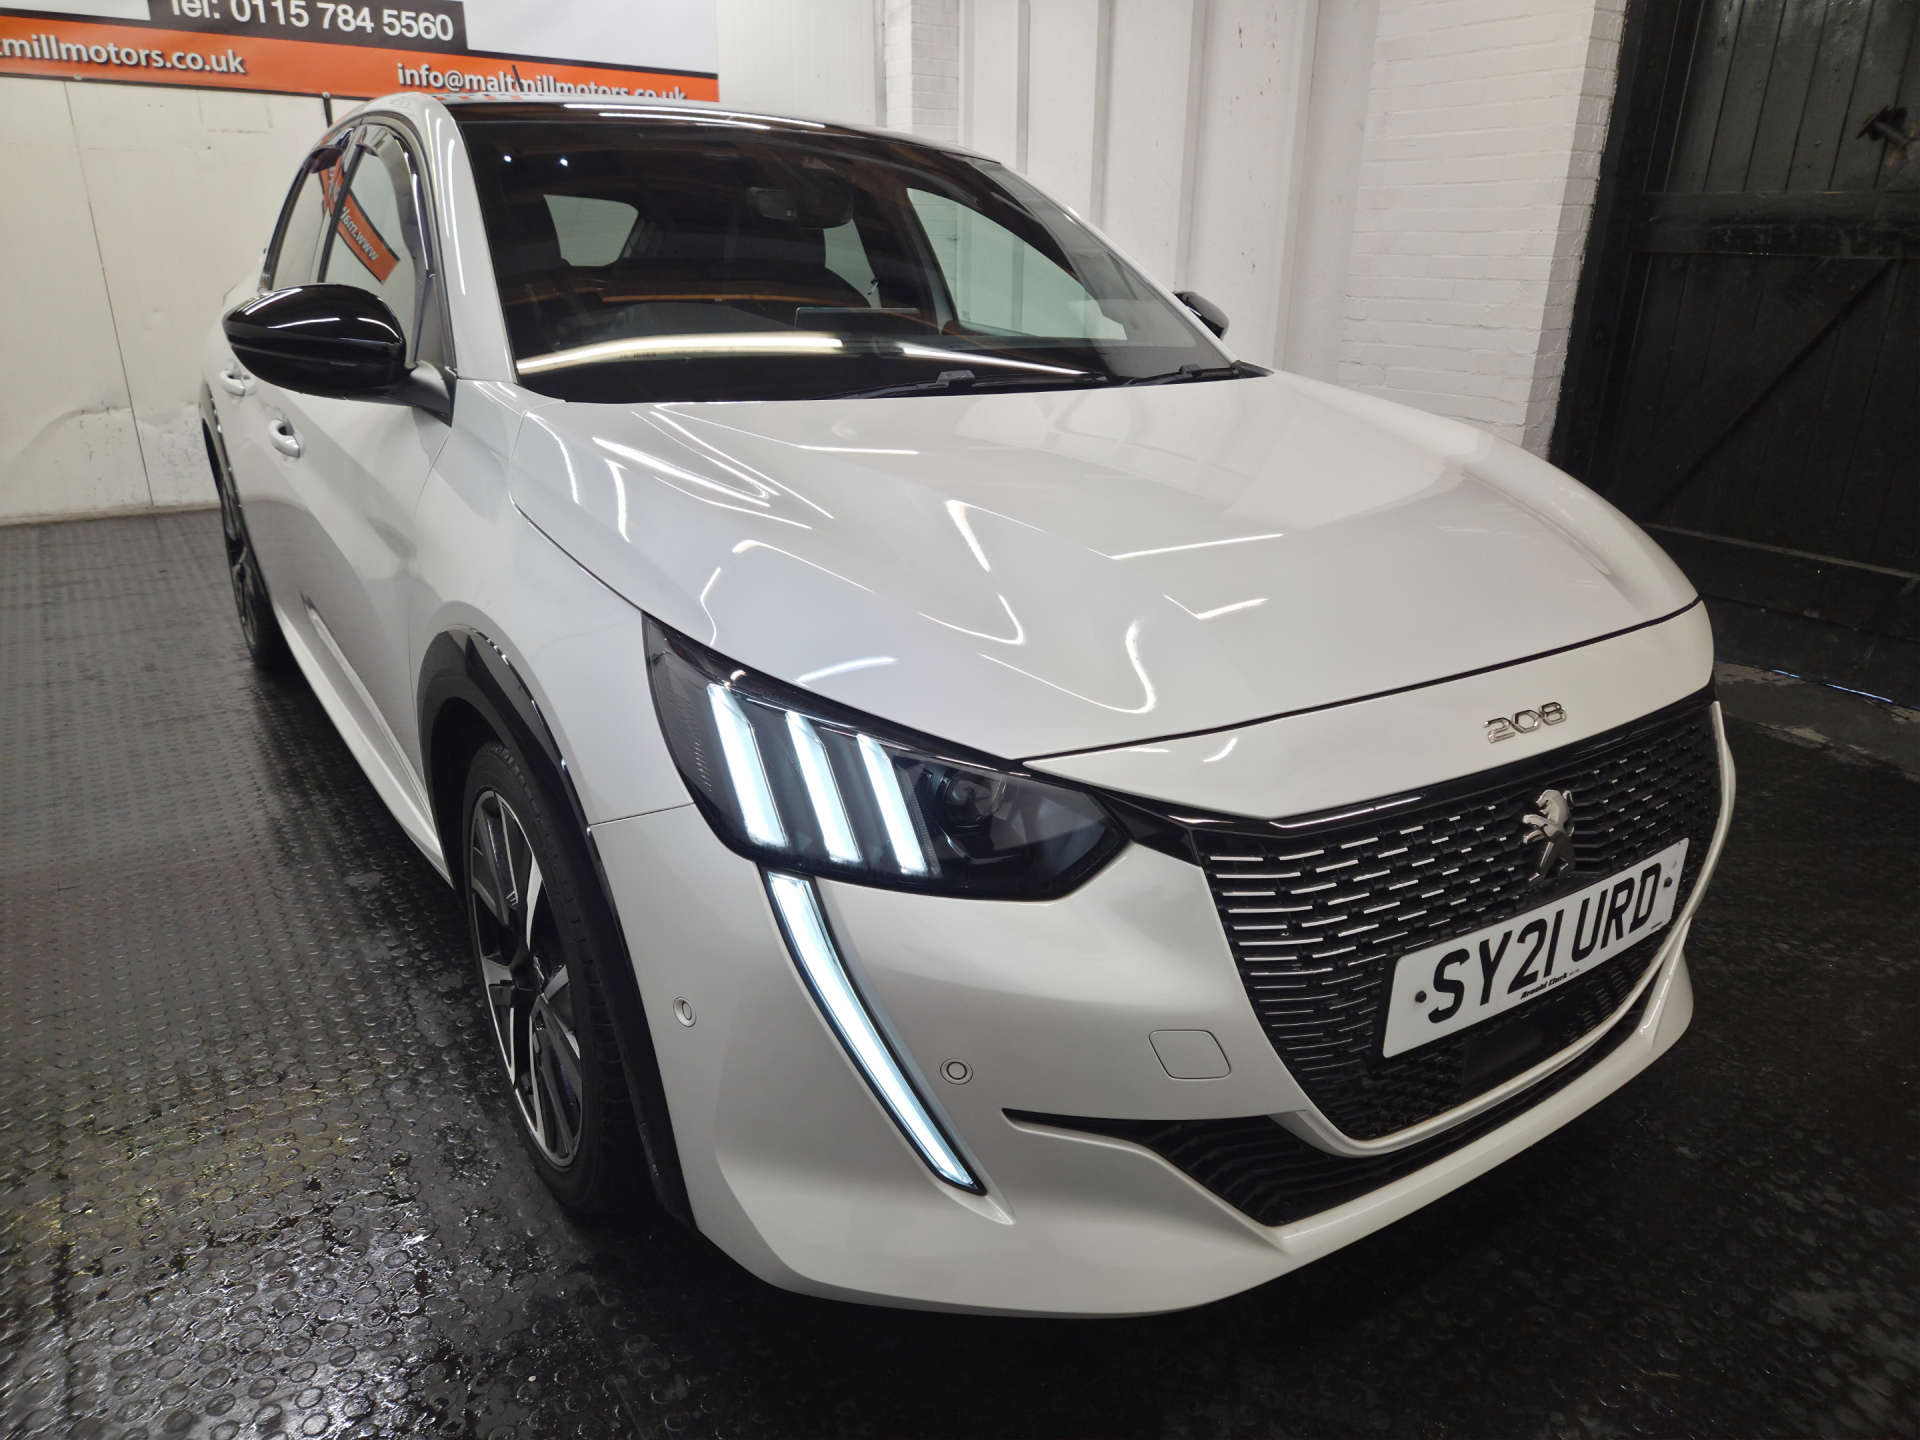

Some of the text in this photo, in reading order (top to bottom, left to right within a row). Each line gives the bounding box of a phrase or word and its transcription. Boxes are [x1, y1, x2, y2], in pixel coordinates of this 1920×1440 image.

[231, 0, 310, 28] 0115
[316, 2, 374, 34] 784
[382, 9, 455, 41] 5560
[0, 33, 246, 75] millmotors.co.uk
[397, 61, 687, 100] info@maltmillmotorscouk
[1484, 701, 1567, 744] 208
[1428, 862, 1662, 1024] SY21 URD
